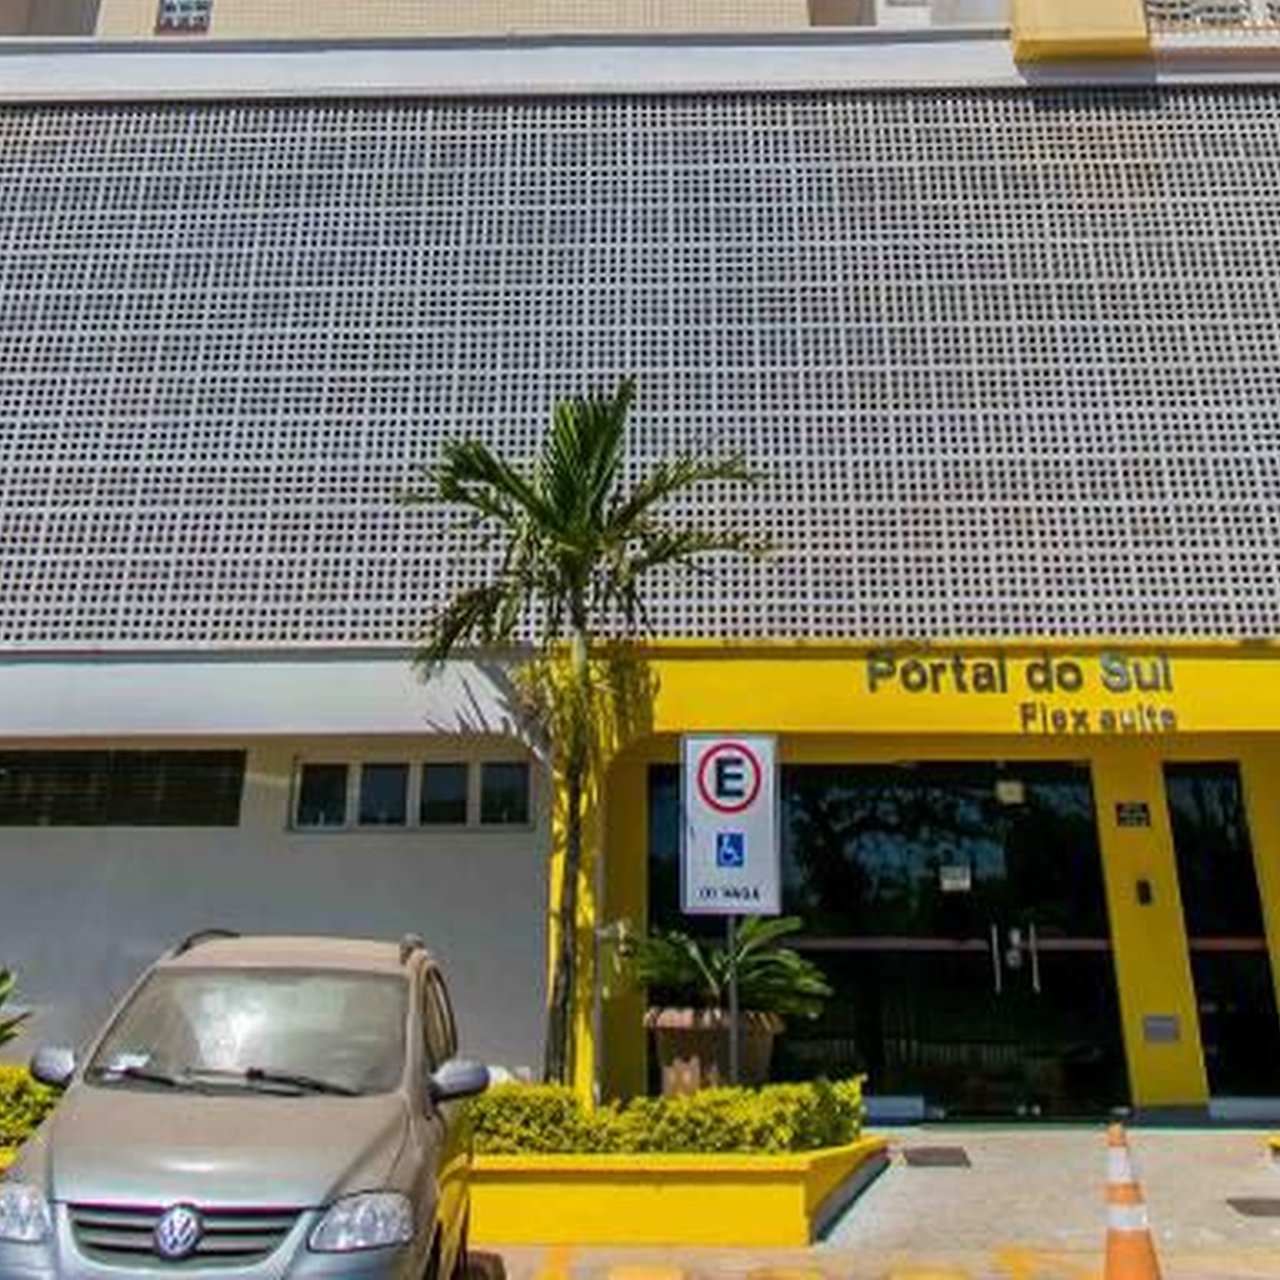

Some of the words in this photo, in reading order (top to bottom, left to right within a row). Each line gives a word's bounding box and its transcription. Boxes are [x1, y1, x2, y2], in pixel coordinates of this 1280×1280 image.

[867, 650, 1008, 694] Portal
[1025, 650, 1084, 694] do
[1099, 650, 1174, 694] Sul
[716, 756, 745, 798] E
